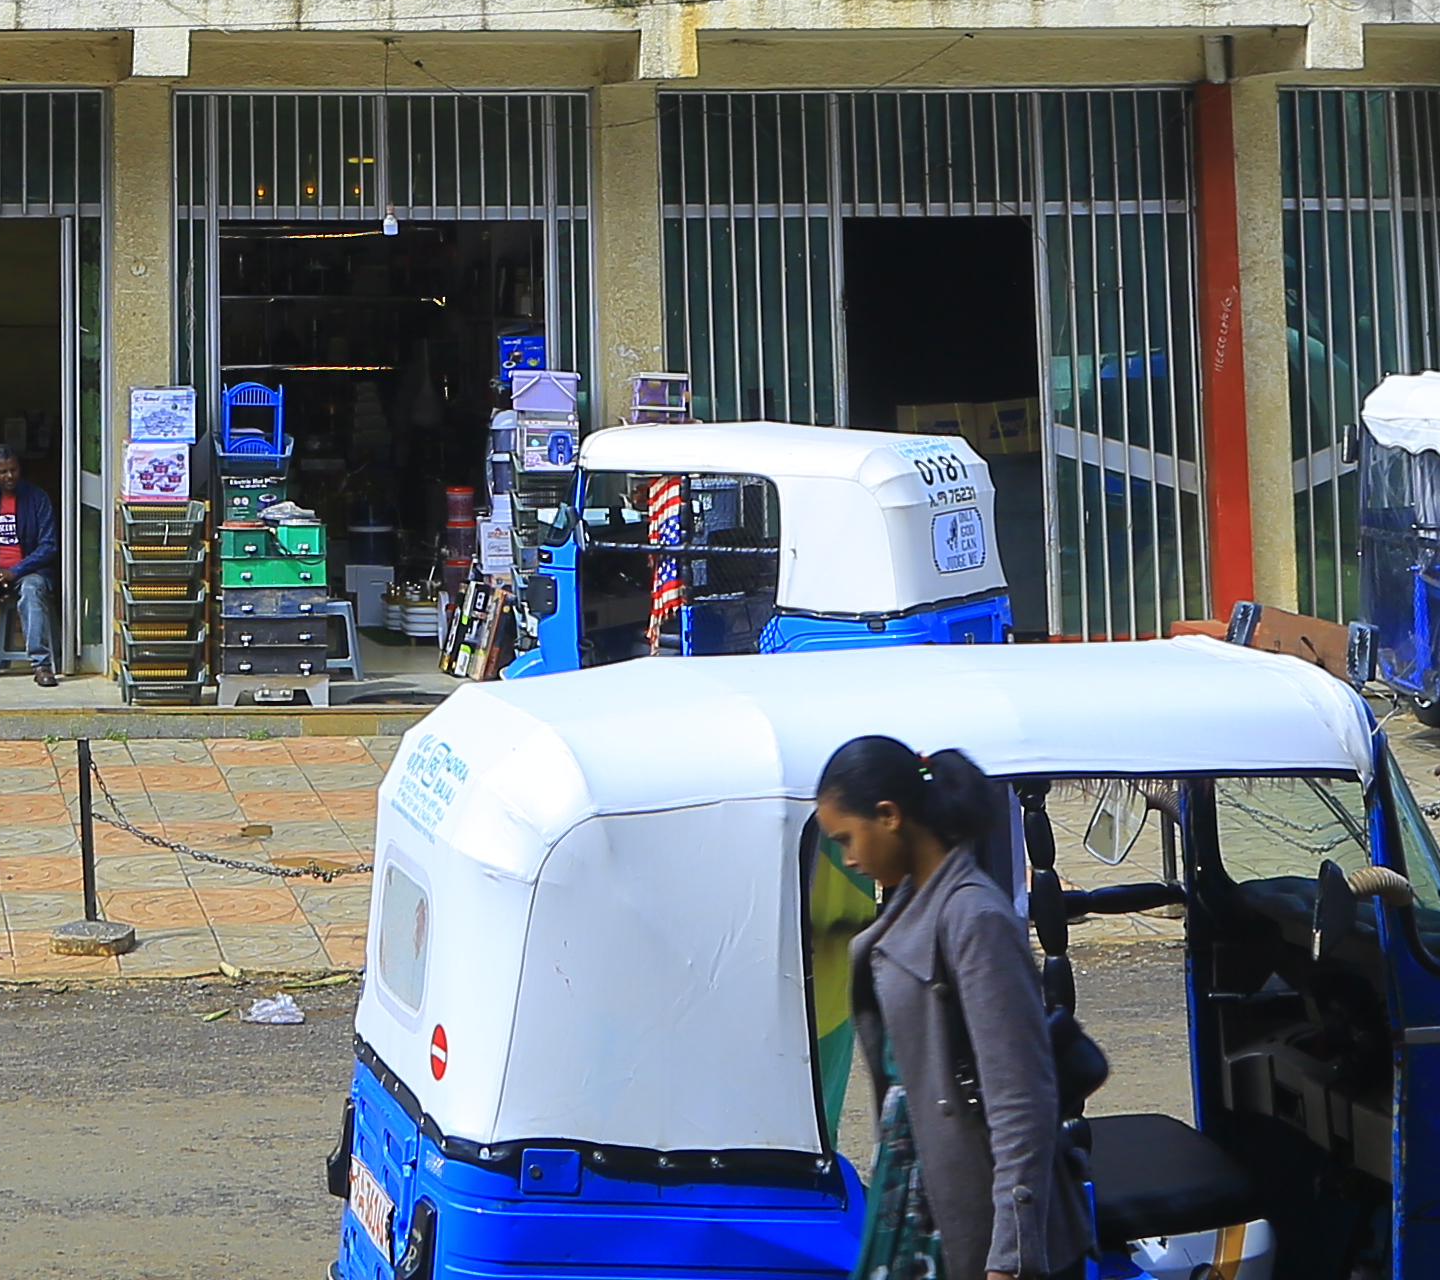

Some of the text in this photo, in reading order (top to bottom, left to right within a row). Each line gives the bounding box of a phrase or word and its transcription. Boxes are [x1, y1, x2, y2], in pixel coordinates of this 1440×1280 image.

[914, 453, 968, 486] 0181
[960, 524, 976, 537] GOD
[961, 538, 978, 552] CAN
